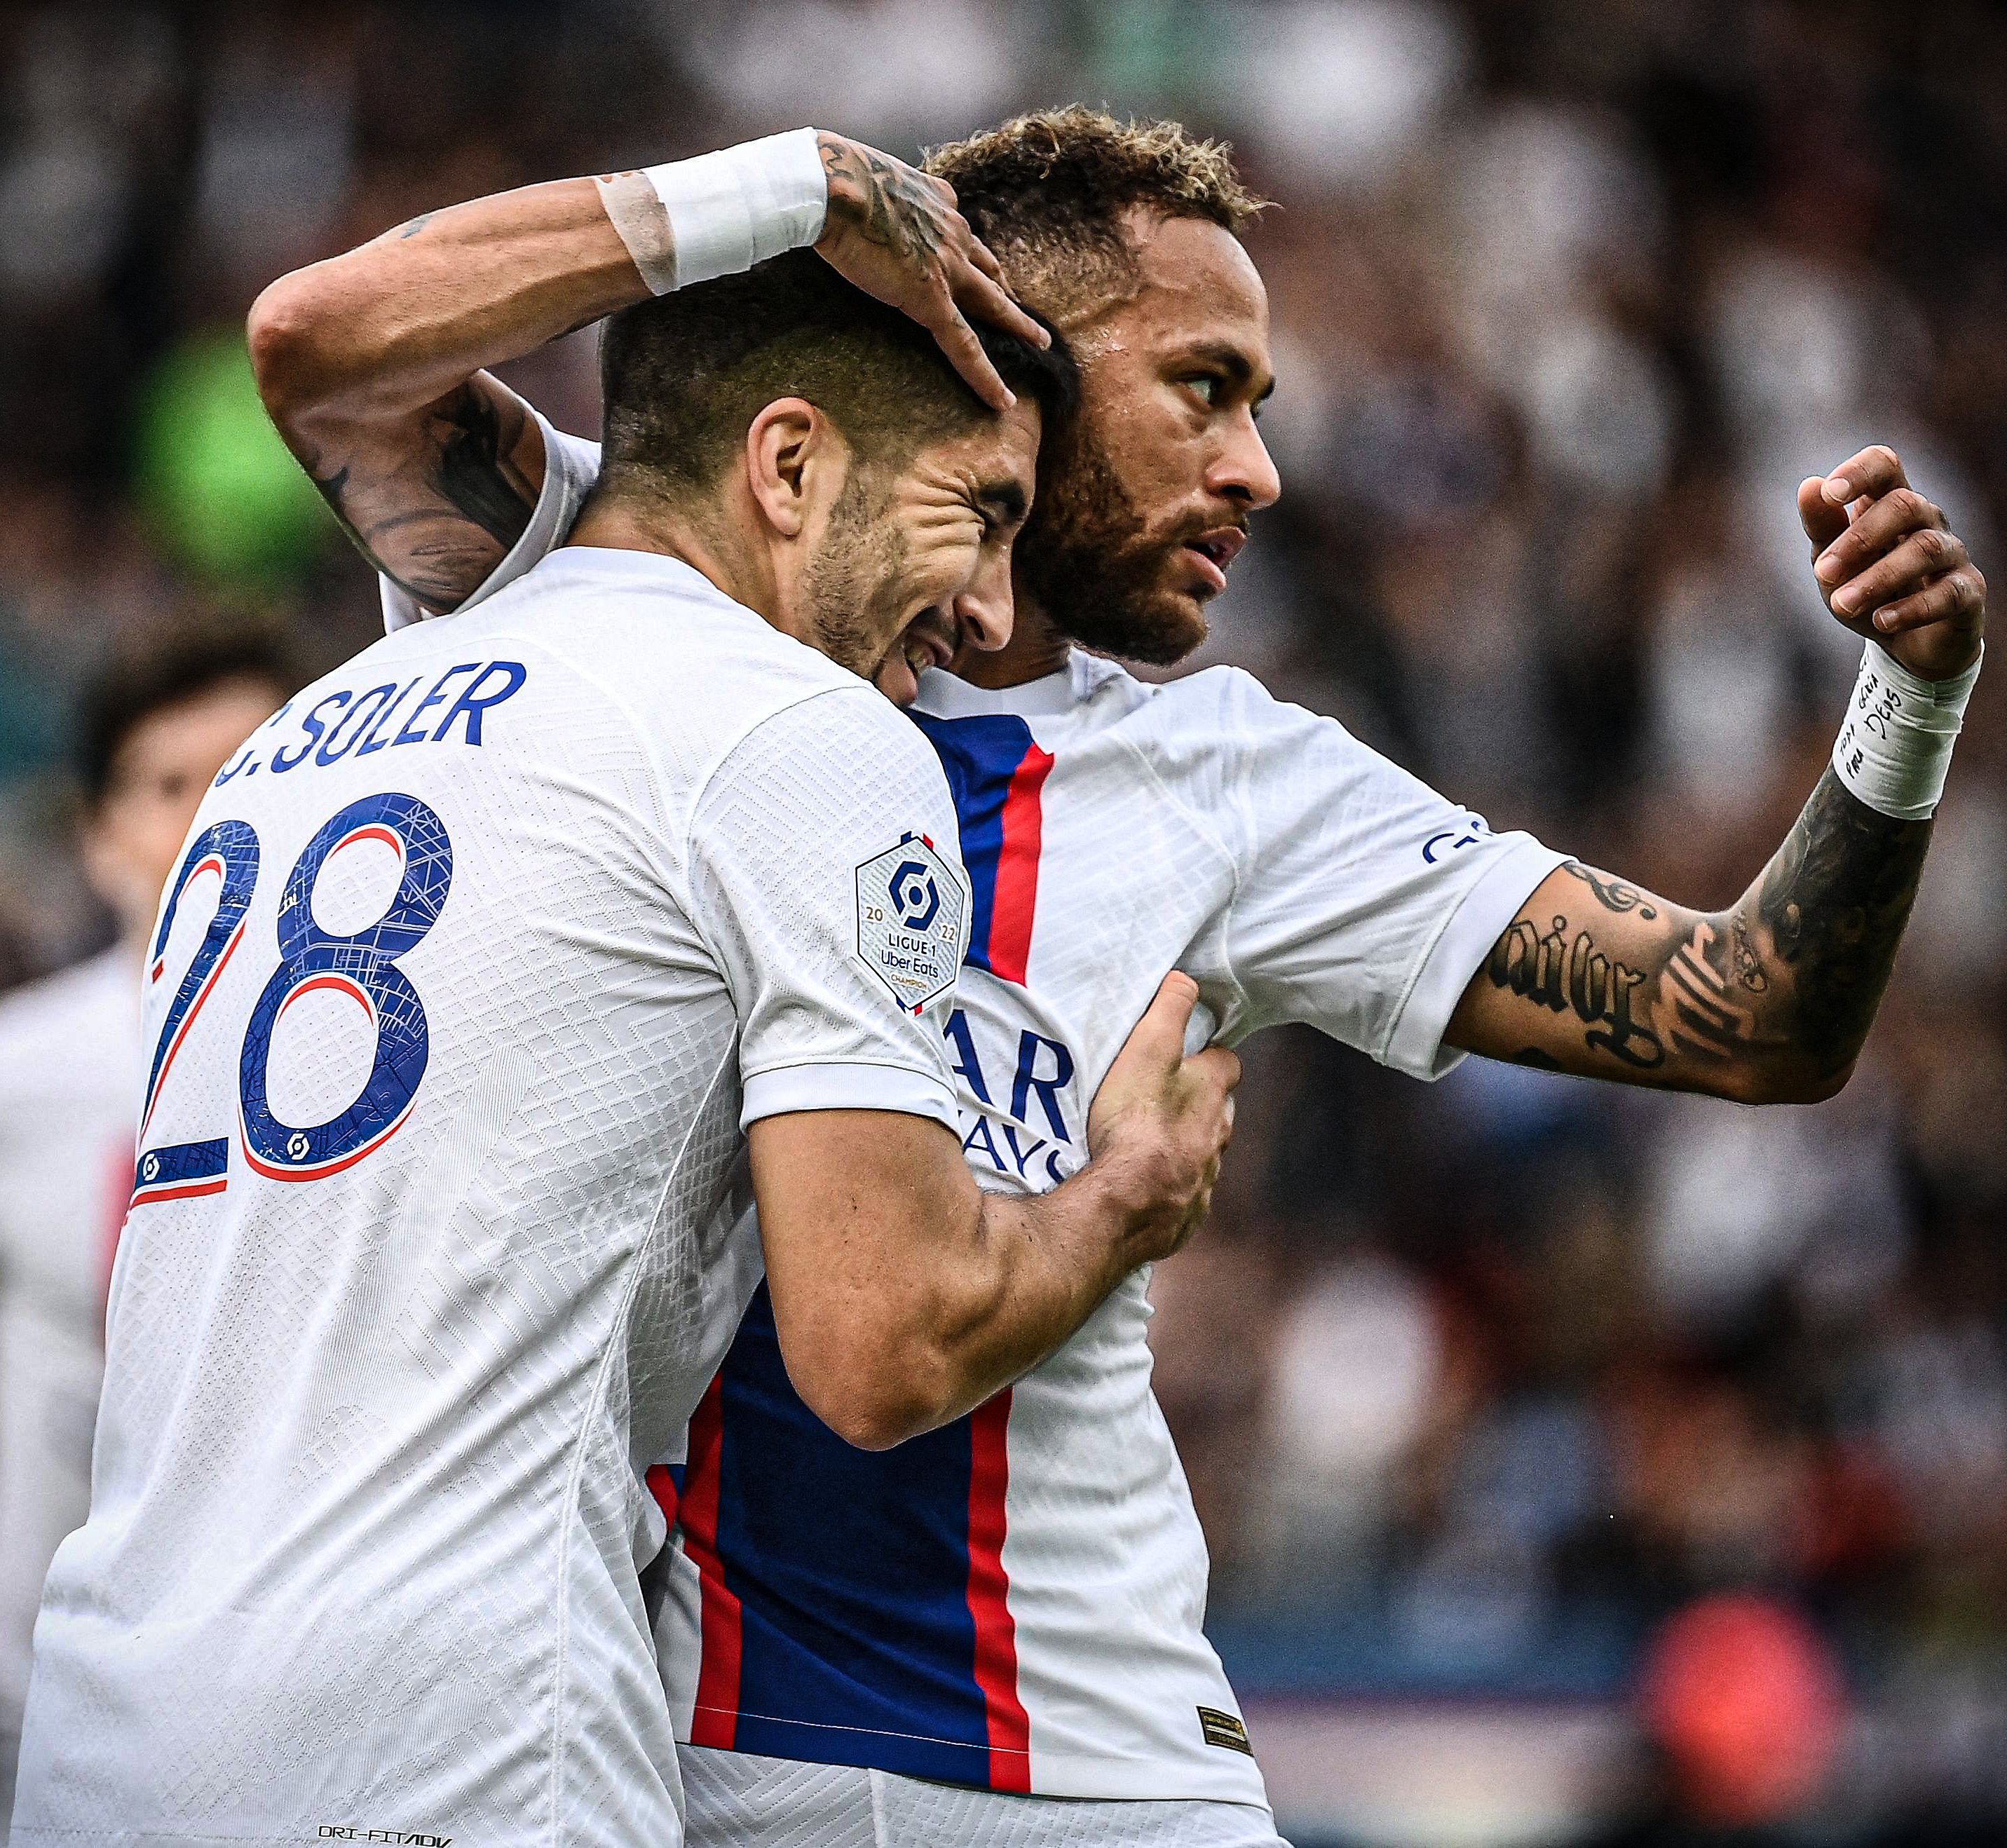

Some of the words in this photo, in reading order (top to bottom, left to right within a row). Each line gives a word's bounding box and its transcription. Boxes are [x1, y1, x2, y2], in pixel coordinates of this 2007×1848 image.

[866, 906, 883, 922] 20
[889, 933, 928, 955] LIGUE
[932, 945, 937, 958] 1
[941, 925, 955, 941] 22
[881, 949, 911, 970] Uber
[913, 958, 939, 979] Eats
[132, 792, 454, 1203] 28
